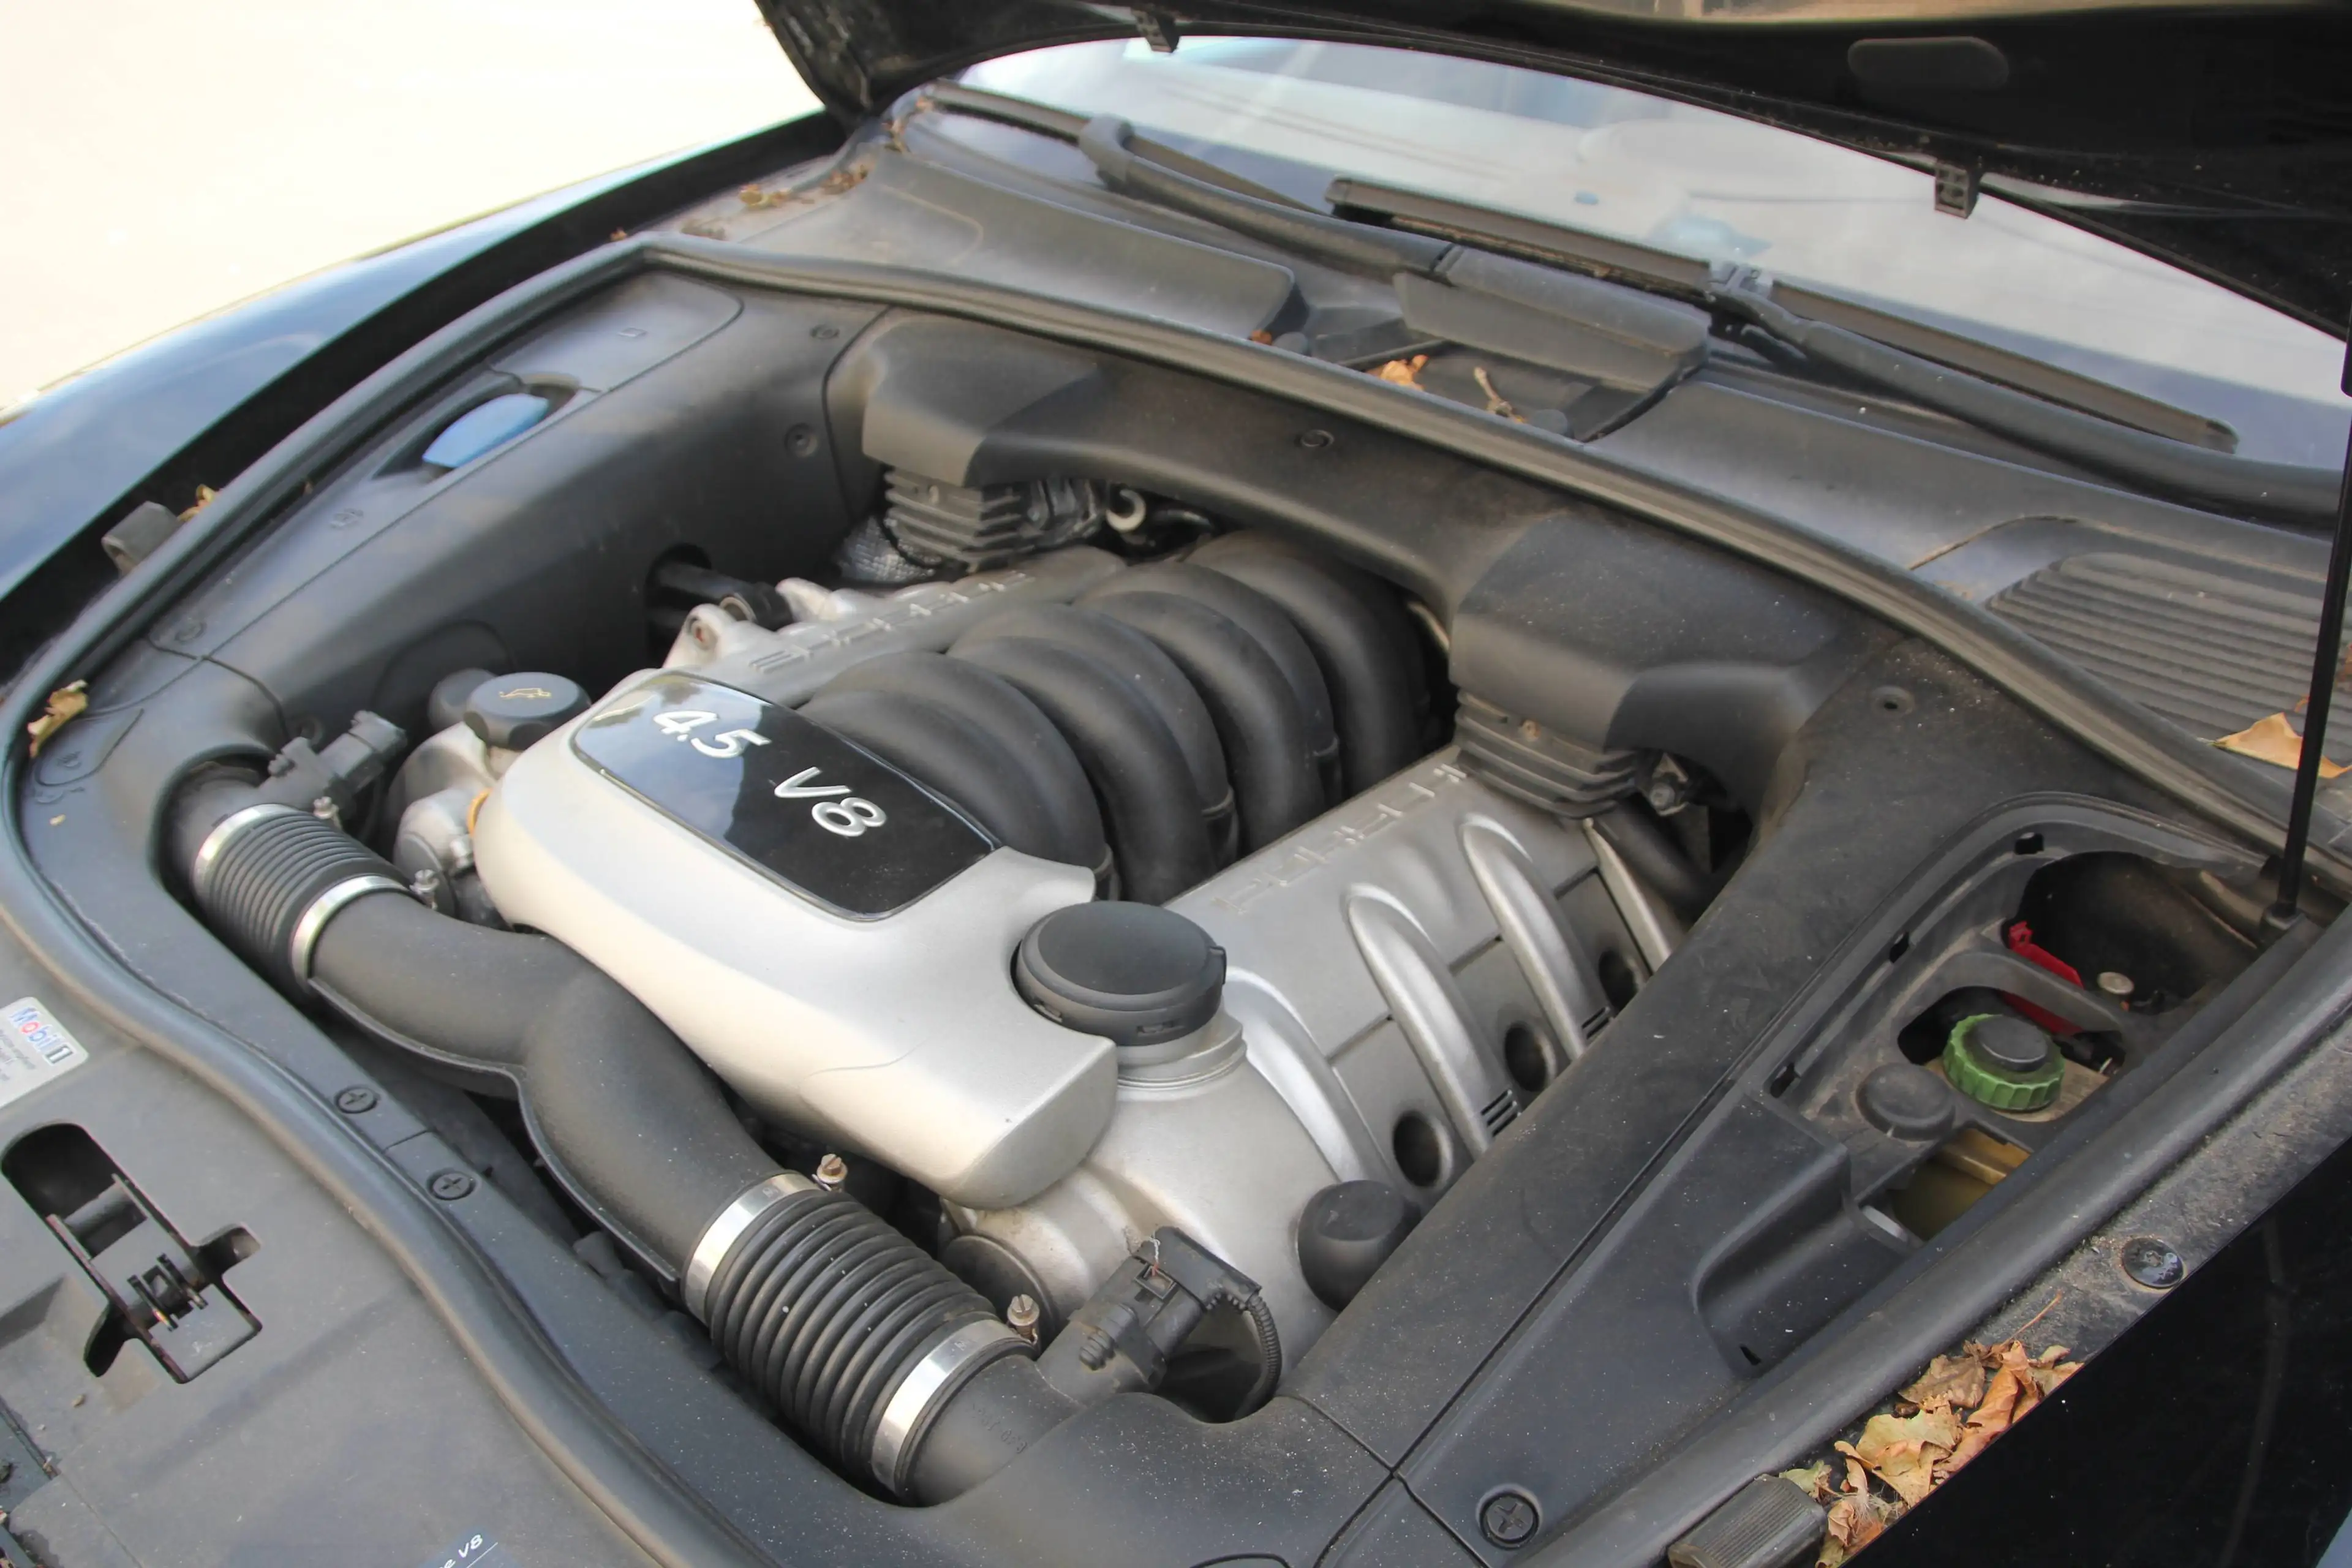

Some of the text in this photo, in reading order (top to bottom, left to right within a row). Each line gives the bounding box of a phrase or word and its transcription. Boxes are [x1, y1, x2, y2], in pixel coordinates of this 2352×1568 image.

[653, 710, 887, 837] 4.5 V8
[9, 1006, 62, 1052] Mobil
[458, 1534, 483, 1558] V8
